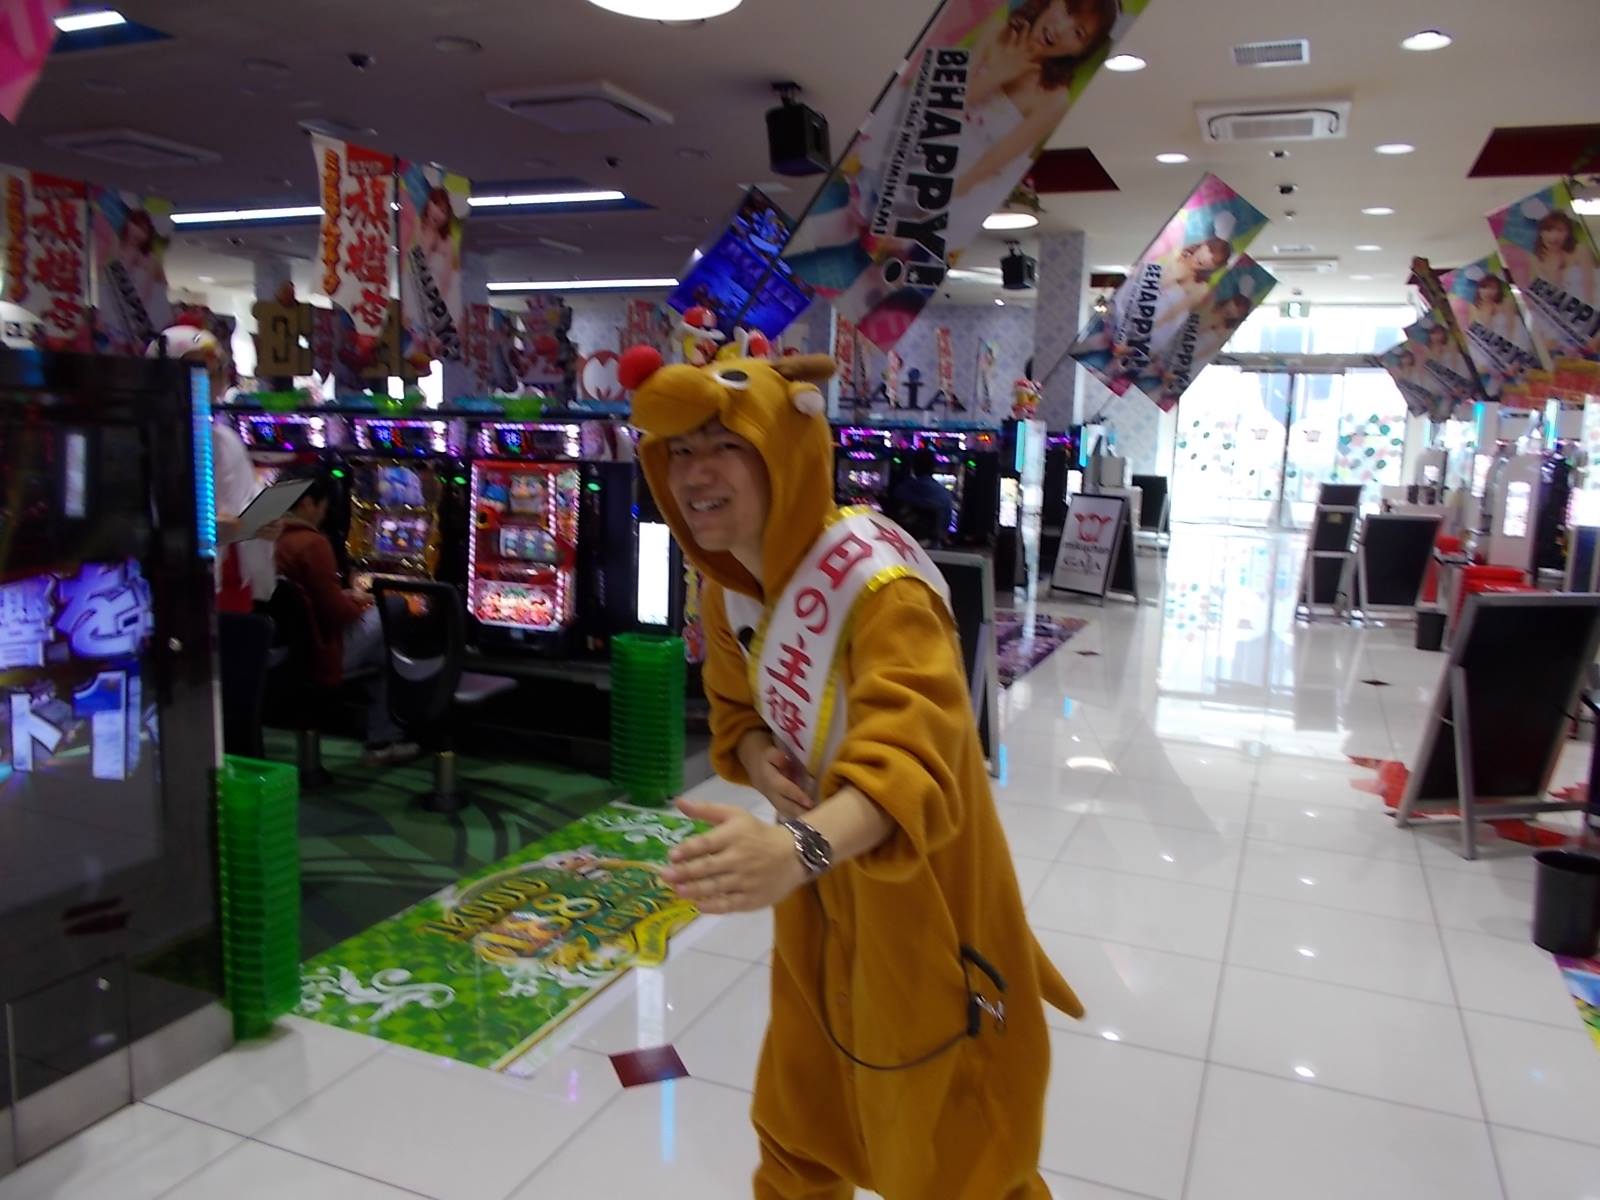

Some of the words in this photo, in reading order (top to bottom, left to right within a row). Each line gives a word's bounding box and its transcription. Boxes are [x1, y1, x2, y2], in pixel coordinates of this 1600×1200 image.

[764, 517, 921, 753] 本日の主役
